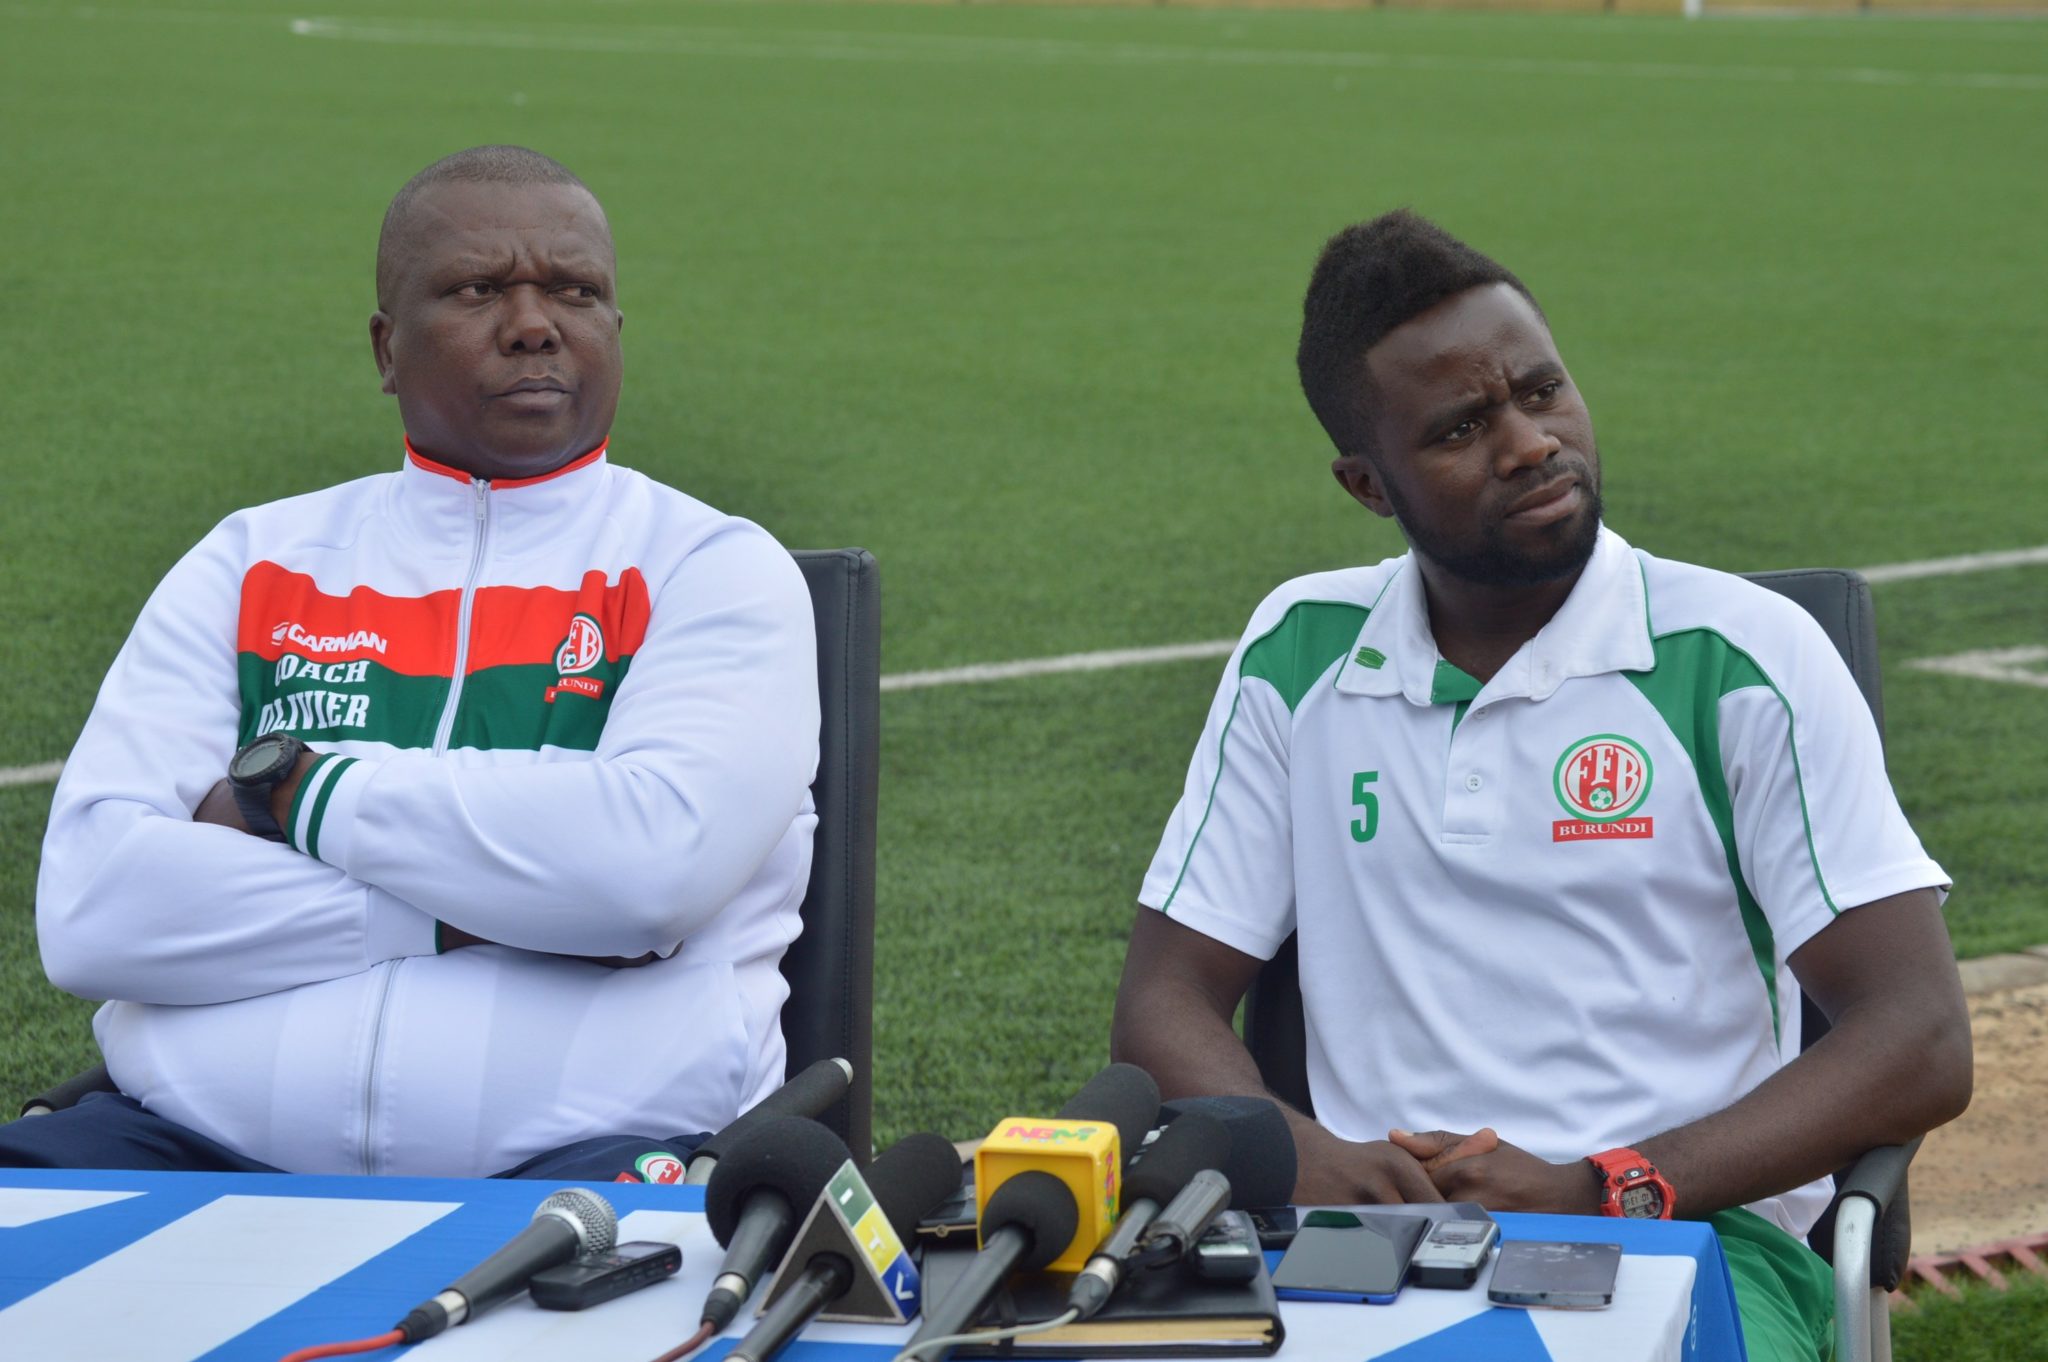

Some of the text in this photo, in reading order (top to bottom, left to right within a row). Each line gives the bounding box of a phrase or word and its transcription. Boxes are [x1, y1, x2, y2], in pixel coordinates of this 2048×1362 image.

[256, 690, 370, 737] OLIVIER
[1569, 744, 1640, 807] FFB
[1350, 771, 1378, 843] 5
[1559, 823, 1648, 837] BURUNDI
